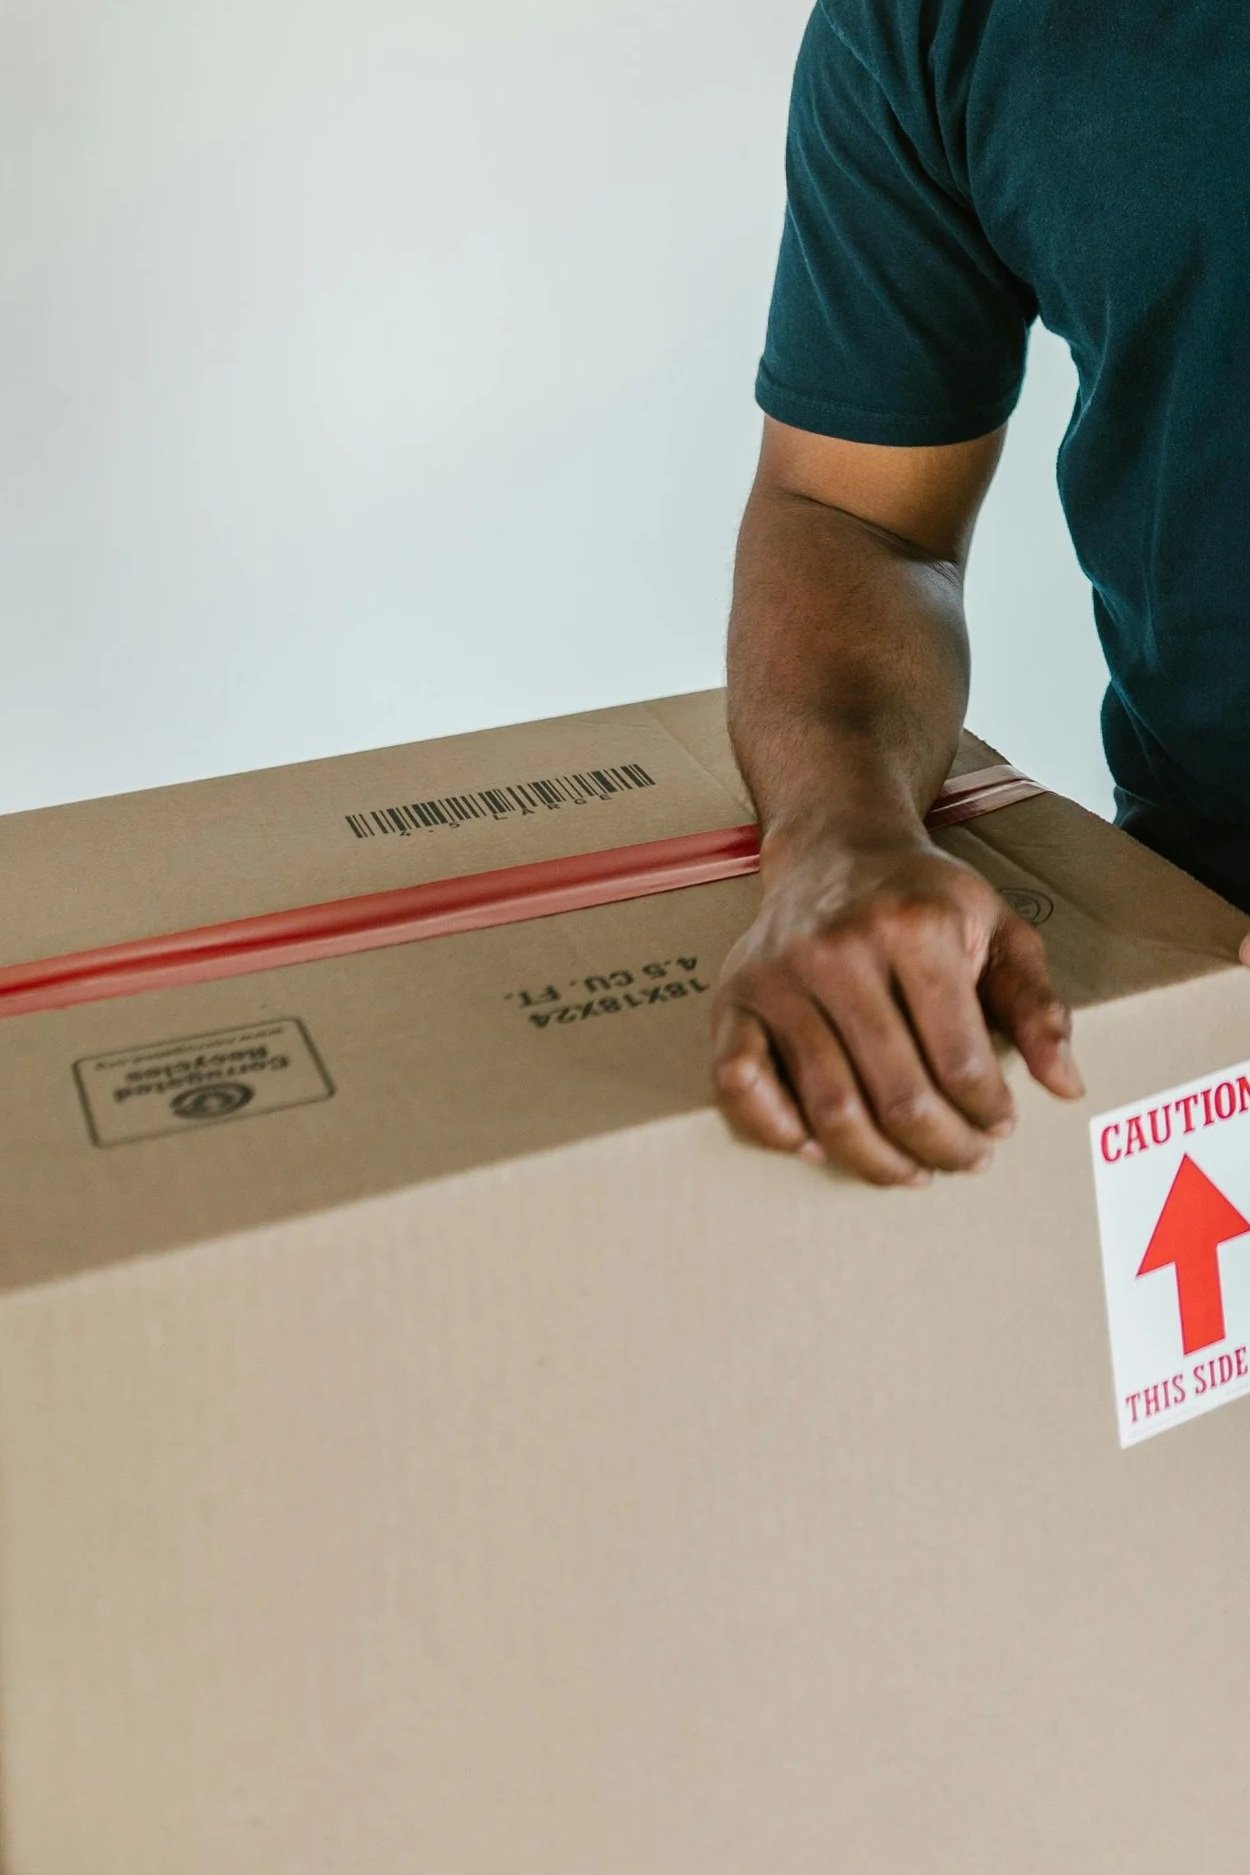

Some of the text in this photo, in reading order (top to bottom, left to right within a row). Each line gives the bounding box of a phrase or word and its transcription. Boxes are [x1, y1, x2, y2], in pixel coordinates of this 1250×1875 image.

[493, 795, 613, 821] LARGE
[503, 956, 698, 1009] 4.5 CU. FT.
[113, 1055, 290, 1103] Corrugated
[125, 1045, 268, 1082] Recycles
[1125, 1373, 1186, 1424] THIS
[1193, 1344, 1249, 1399] SIDE
